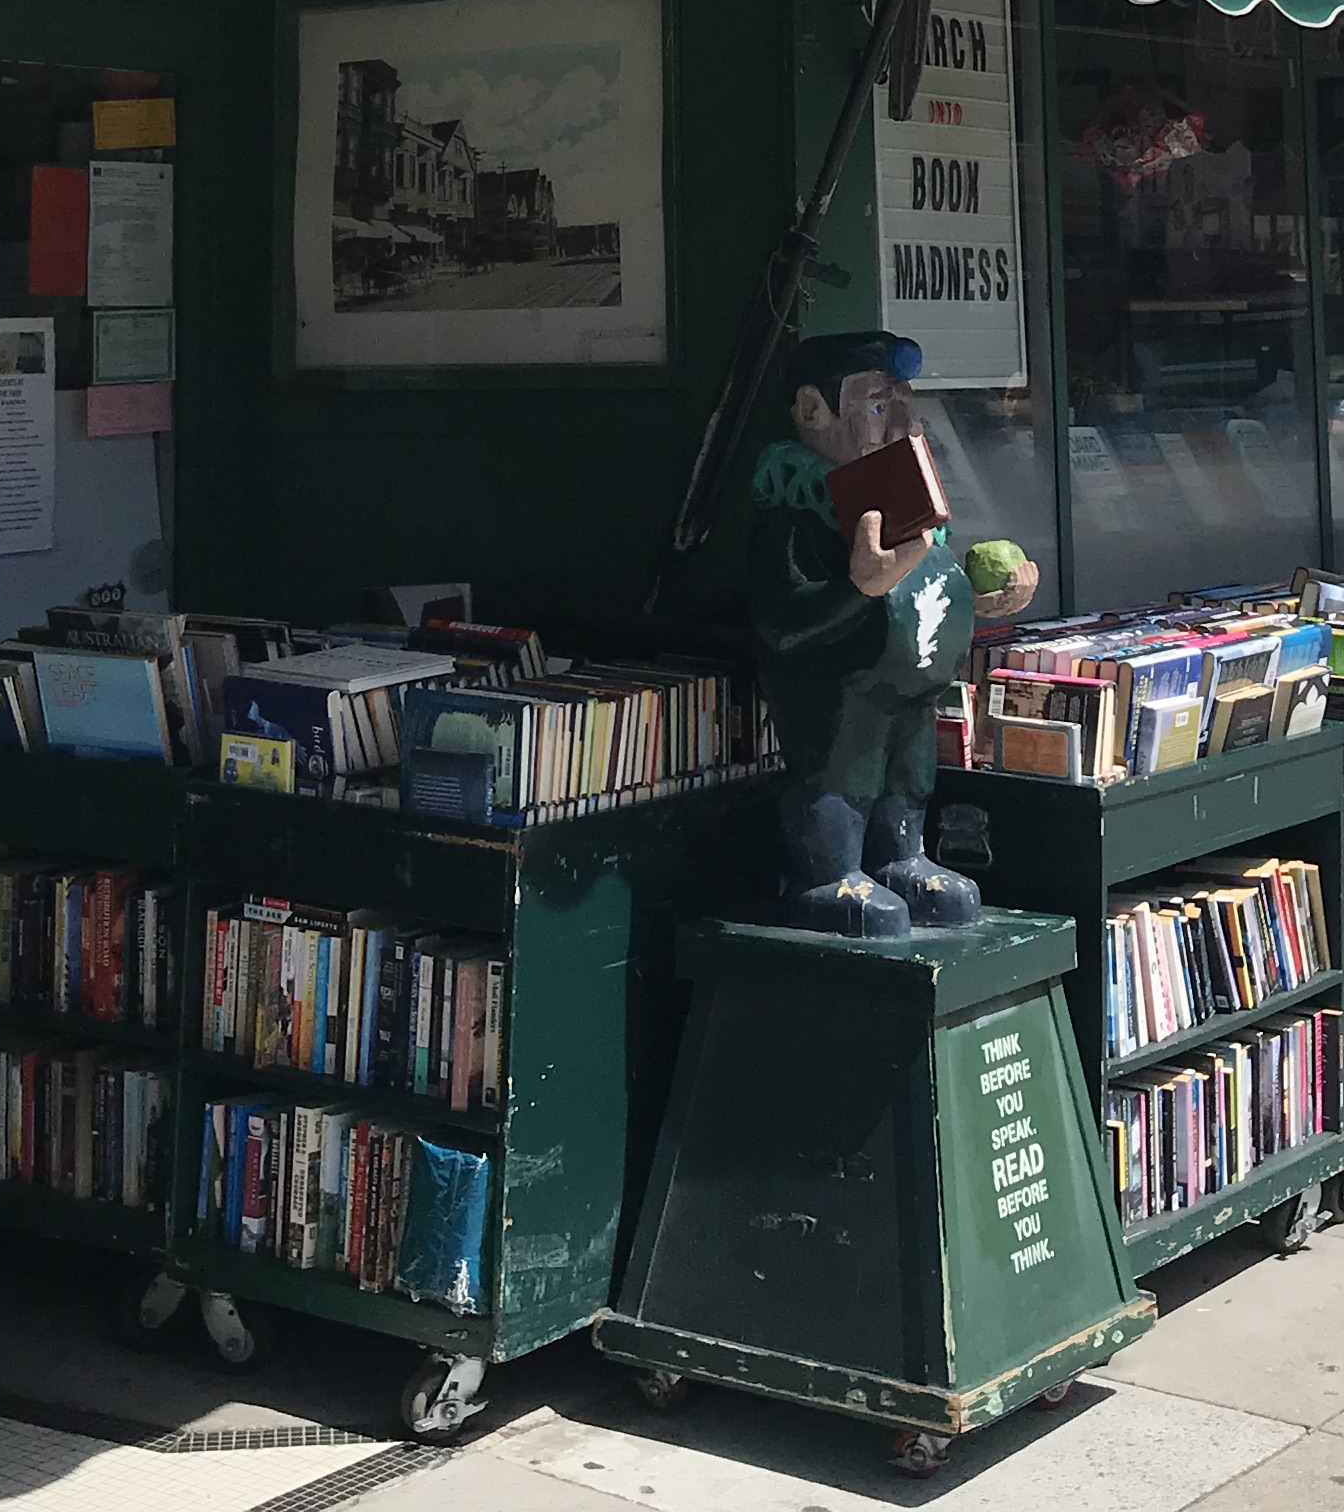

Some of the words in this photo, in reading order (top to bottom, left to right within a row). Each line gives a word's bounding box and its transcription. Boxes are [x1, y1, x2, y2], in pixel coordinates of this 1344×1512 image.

[925, 14, 987, 72] RCH
[912, 155, 979, 214] BOOK
[894, 243, 1010, 302] MADNESS
[981, 1032, 1022, 1064] THINK
[980, 1058, 1032, 1095] BEFORE
[996, 1090, 1024, 1118] YOU
[991, 1116, 1038, 1151] SPEAK.
[992, 1143, 1045, 1192] READ
[997, 1179, 1049, 1219] BEFORE
[1013, 1212, 1041, 1241] YOU
[1010, 1238, 1055, 1274] THINK.
